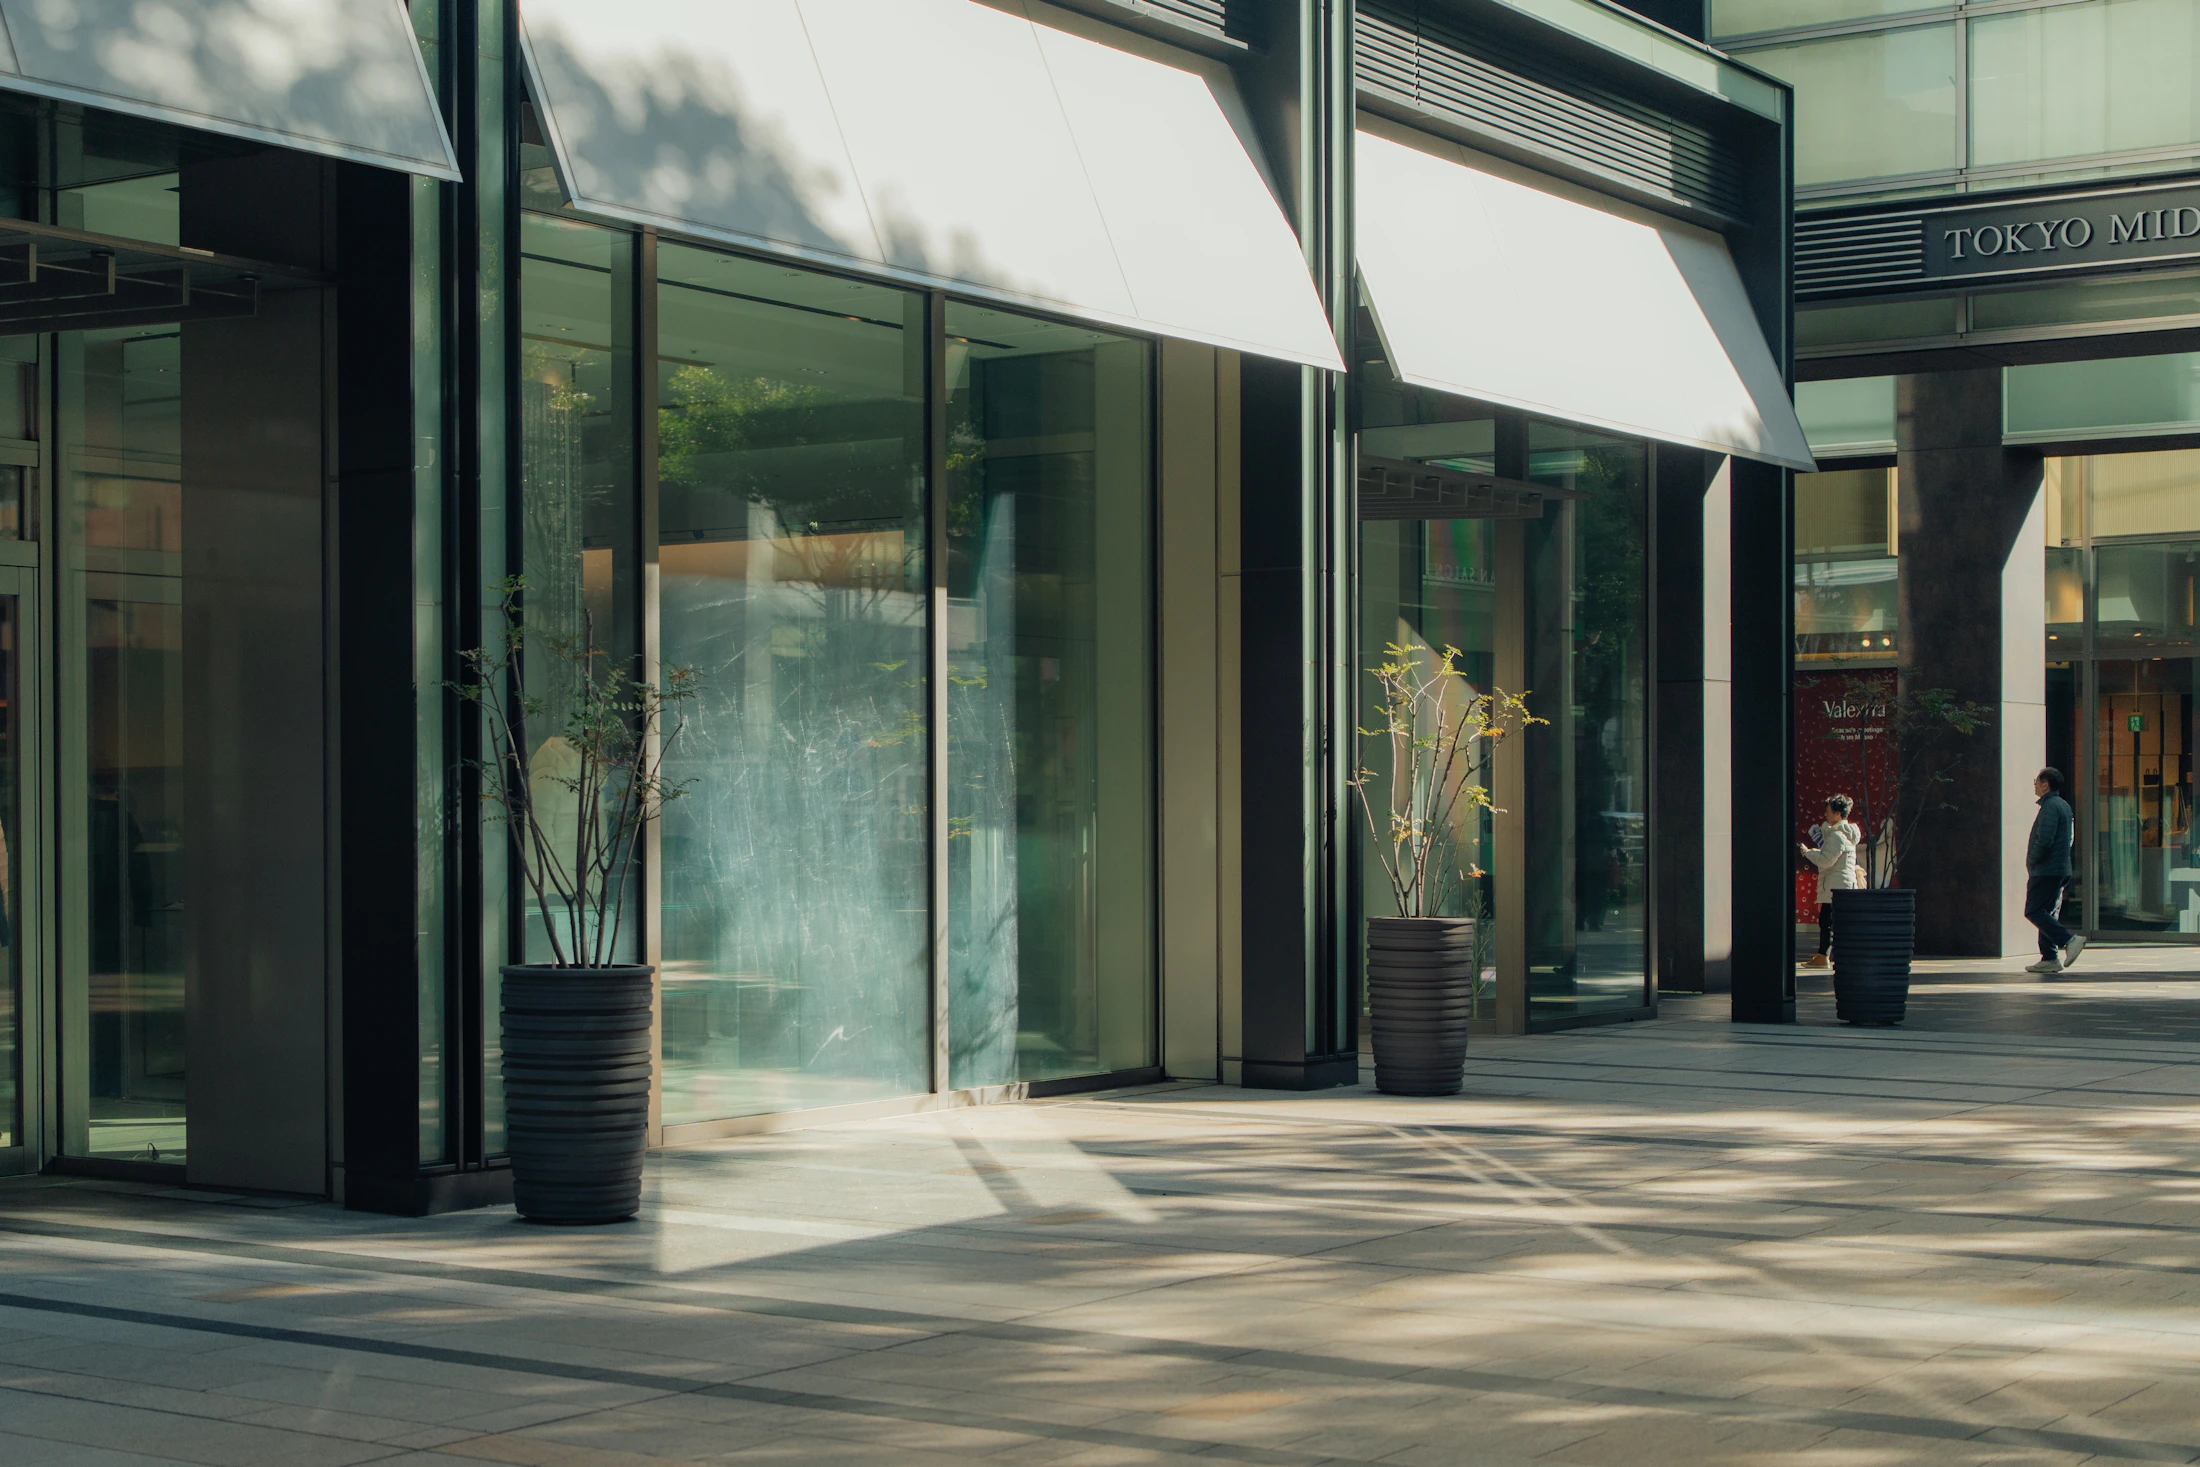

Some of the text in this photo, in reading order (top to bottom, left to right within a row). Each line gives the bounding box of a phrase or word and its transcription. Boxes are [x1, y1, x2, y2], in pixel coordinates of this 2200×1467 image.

[1944, 206, 2200, 259] TOKYO MID
[1857, 726, 1884, 734] geetings
